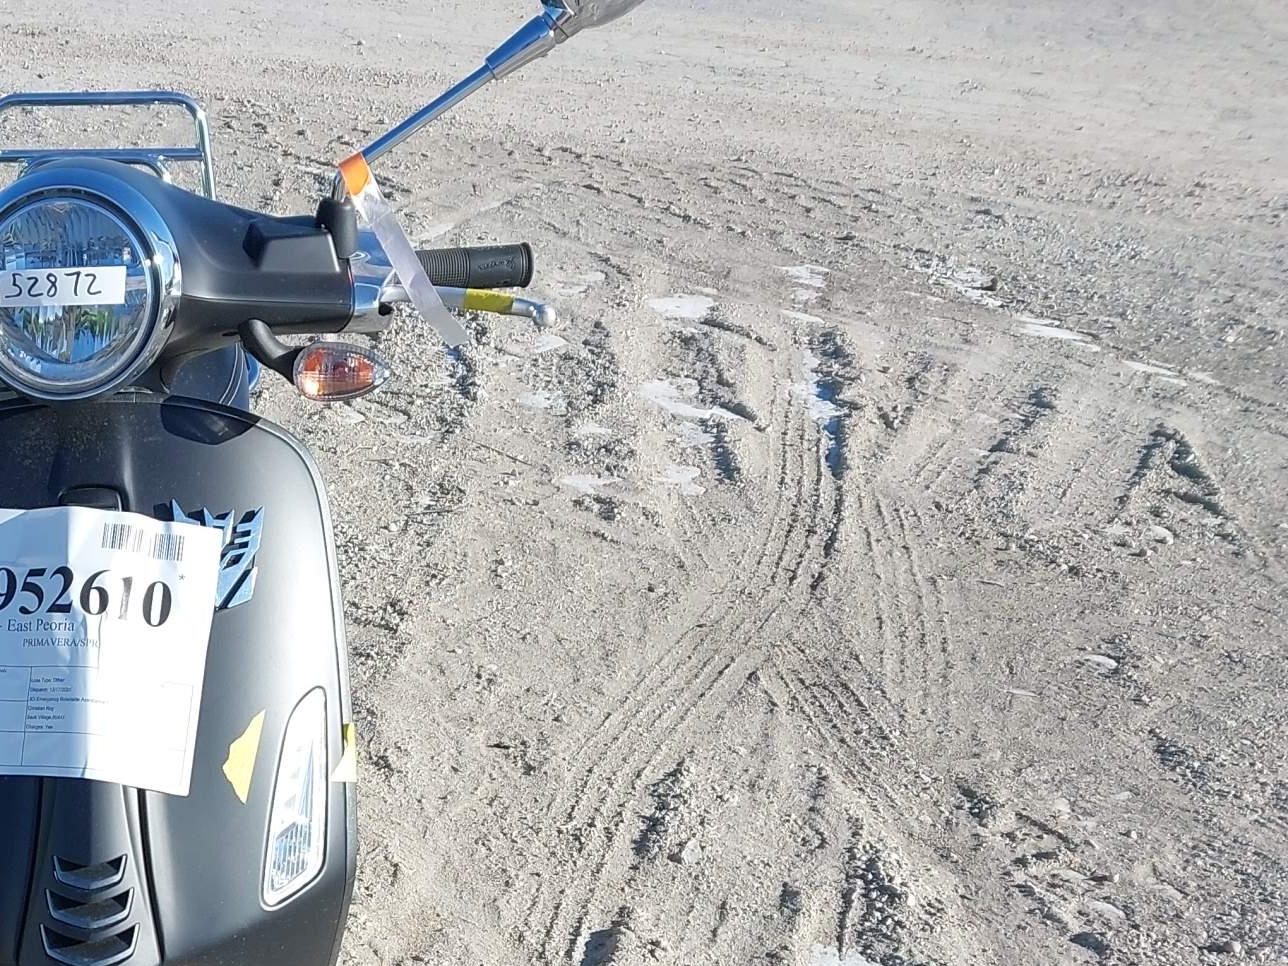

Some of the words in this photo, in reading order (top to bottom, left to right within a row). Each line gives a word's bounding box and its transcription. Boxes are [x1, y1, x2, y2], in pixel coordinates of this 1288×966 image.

[5, 271, 102, 298] 52872
[7, 618, 32, 632] East
[36, 618, 74, 632] Peoria
